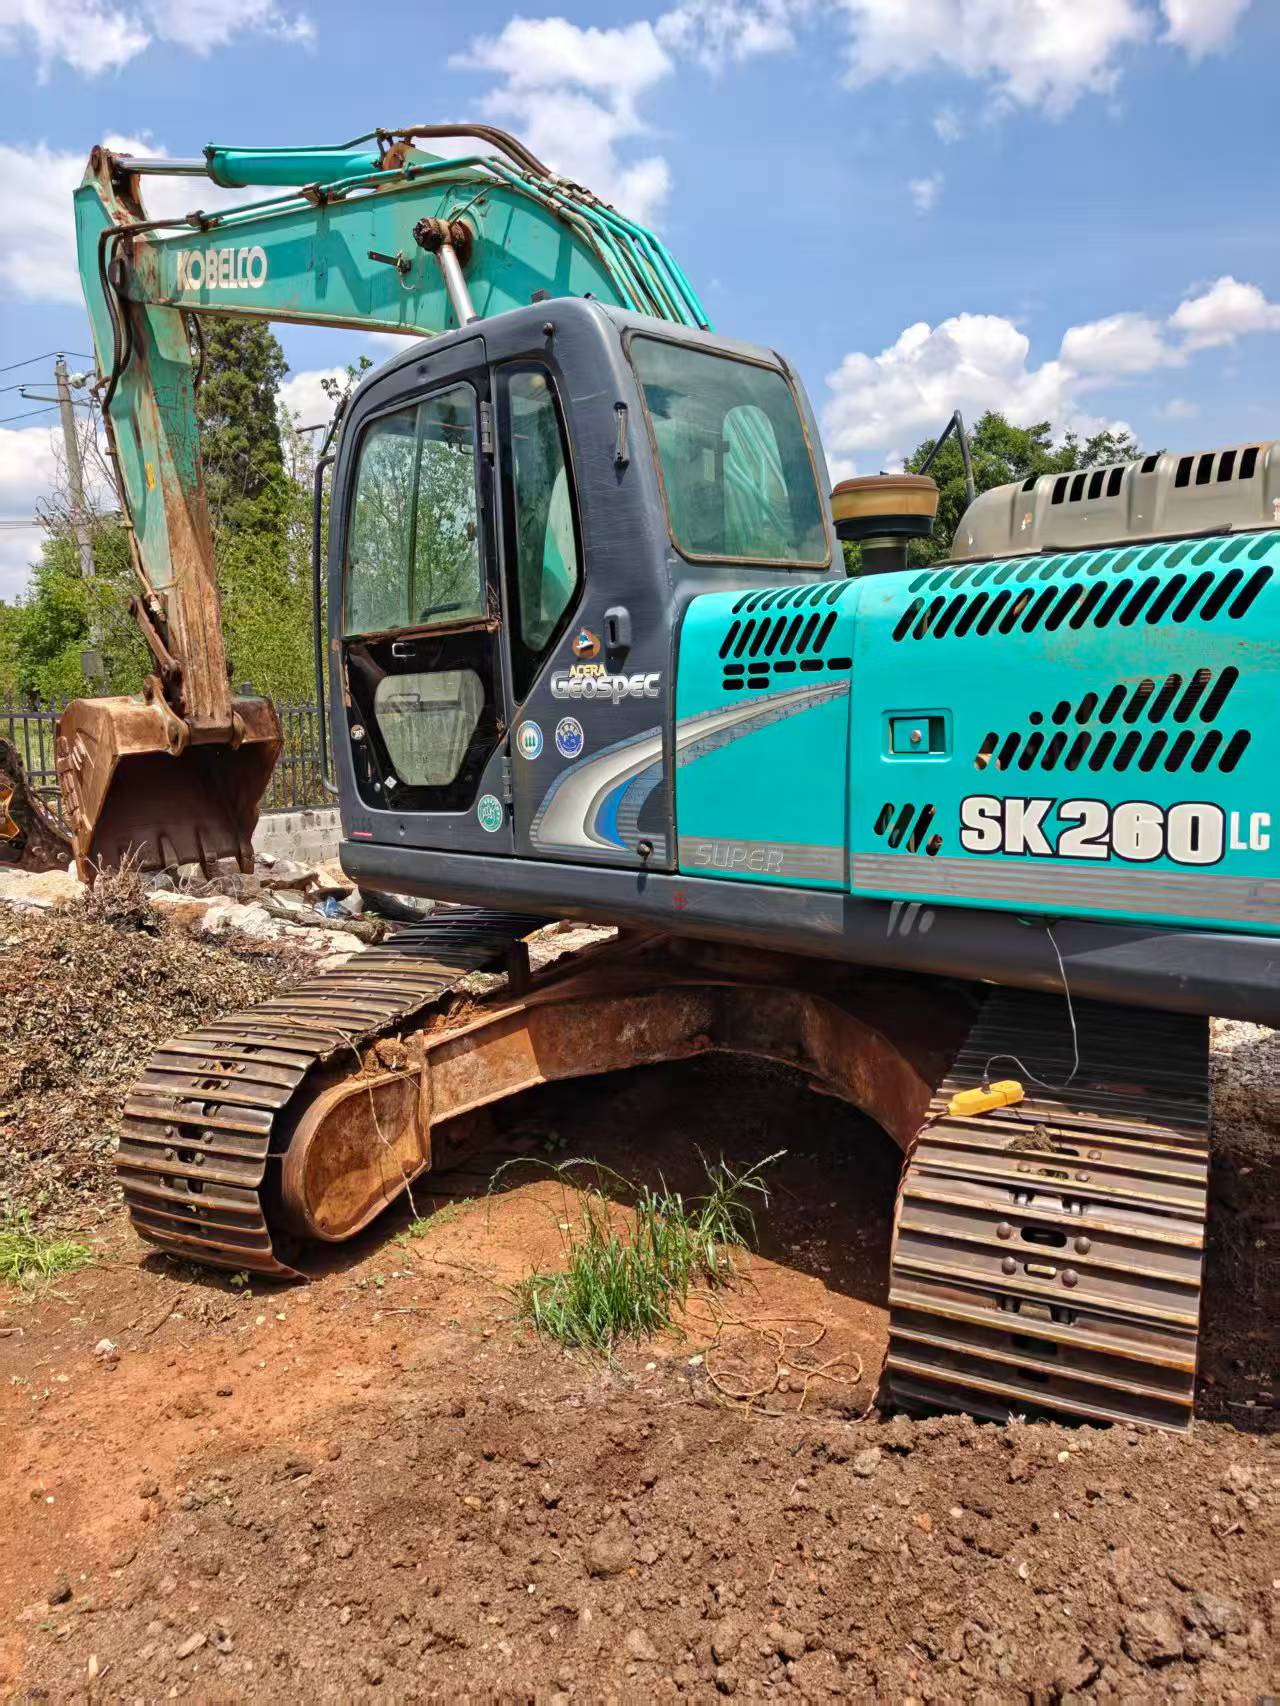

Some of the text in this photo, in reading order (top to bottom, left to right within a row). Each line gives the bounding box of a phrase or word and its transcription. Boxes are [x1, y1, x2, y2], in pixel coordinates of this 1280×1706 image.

[176, 246, 267, 290] KOBELCO
[569, 663, 607, 678] ACERA
[960, 794, 1271, 866] SK260 LC
[694, 841, 784, 872] SUPER
